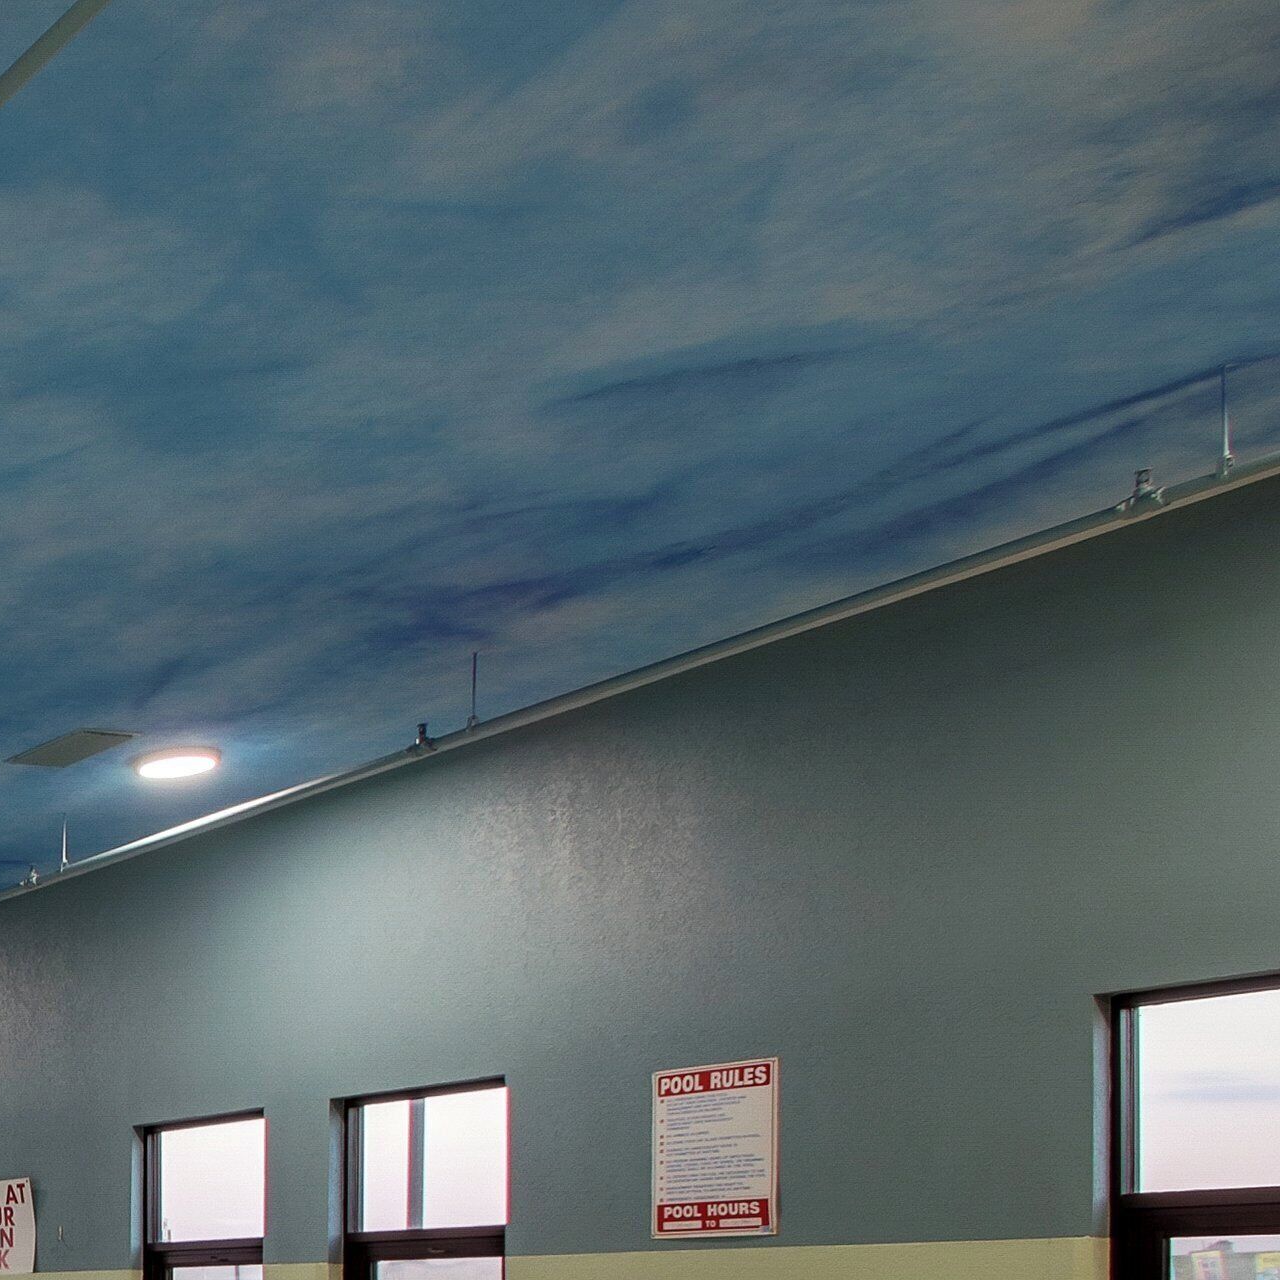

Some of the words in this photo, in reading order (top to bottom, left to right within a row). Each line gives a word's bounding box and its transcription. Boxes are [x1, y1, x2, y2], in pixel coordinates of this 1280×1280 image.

[660, 1074, 704, 1095] POOL
[710, 1066, 768, 1090] RULES
[5, 1183, 26, 1205] AT
[663, 1203, 702, 1219] POOL
[707, 1201, 761, 1217] HOURS
[704, 1219, 716, 1228] TO
